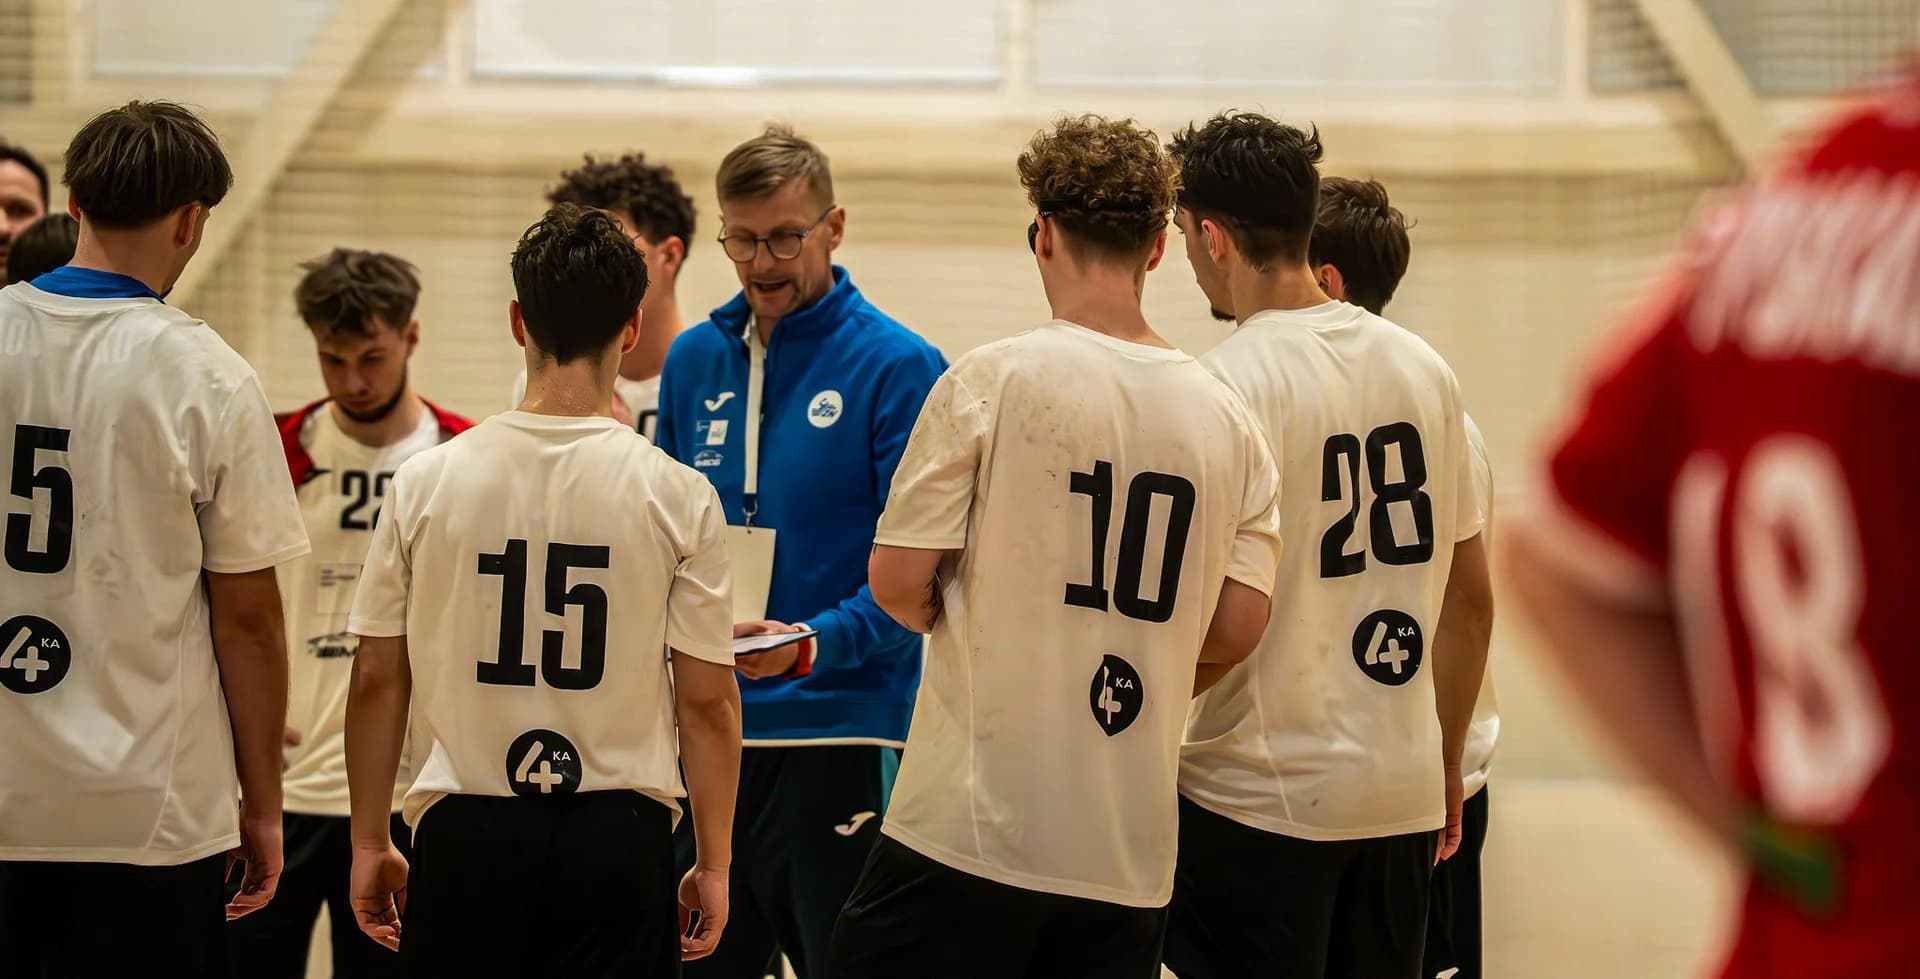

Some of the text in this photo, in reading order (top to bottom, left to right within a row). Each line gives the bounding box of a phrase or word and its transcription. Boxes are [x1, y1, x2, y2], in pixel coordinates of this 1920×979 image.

[4, 424, 74, 574] 5
[1064, 460, 1195, 623] 10
[1320, 422, 1434, 578] 28
[476, 538, 610, 690] 15
[1668, 438, 1892, 825] 18
